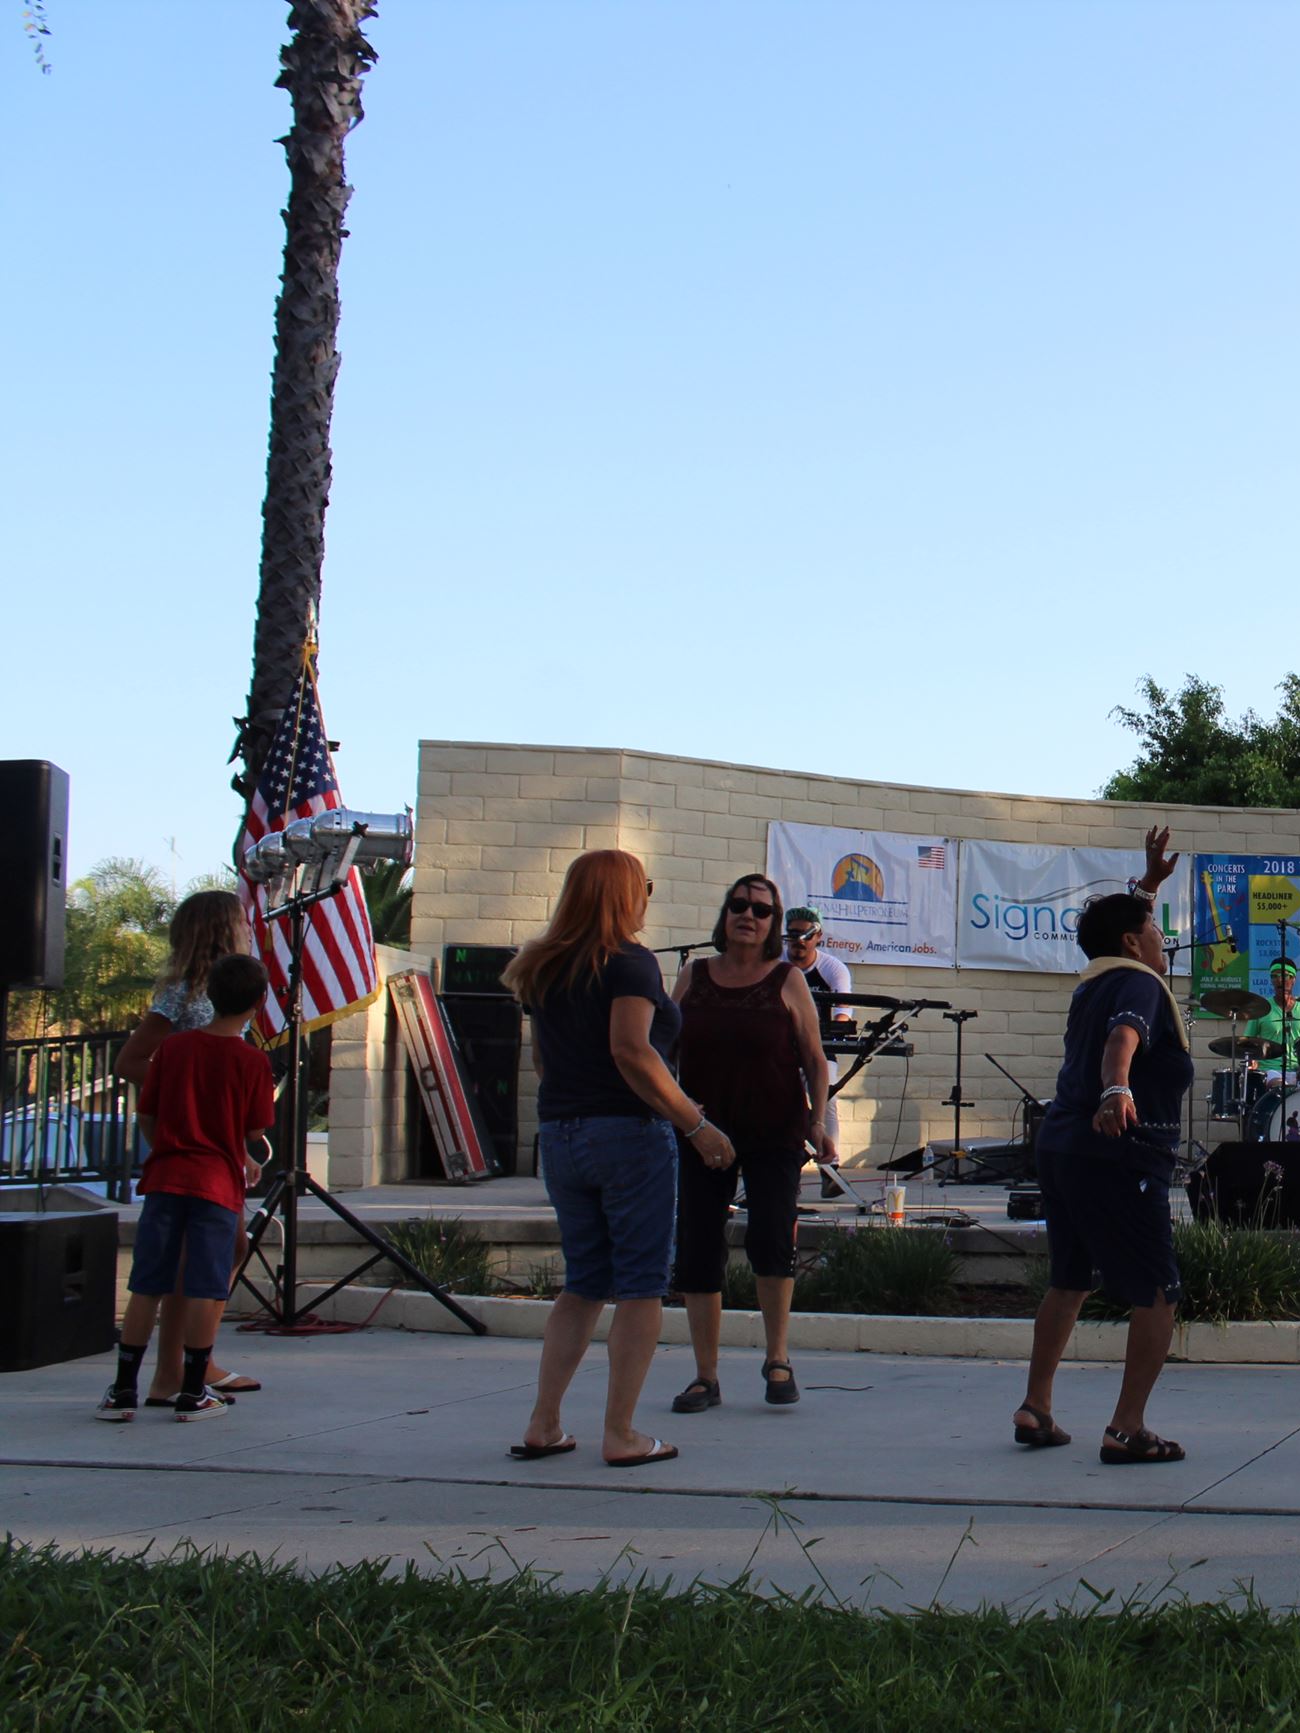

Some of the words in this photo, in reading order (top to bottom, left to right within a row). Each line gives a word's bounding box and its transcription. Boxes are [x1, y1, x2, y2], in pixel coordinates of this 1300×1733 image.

[1207, 863, 1246, 874] CONCERTS
[1263, 860, 1295, 874] 2018
[1225, 875, 1237, 883] THE
[1217, 884, 1237, 894] PARK
[1252, 892, 1293, 900] HEADLINER
[970, 893, 1079, 941] Signa
[1034, 932, 1077, 942] COMMU
[826, 937, 863, 953] Energy.
[866, 940, 911, 954] American
[912, 944, 937, 954] Jobs.
